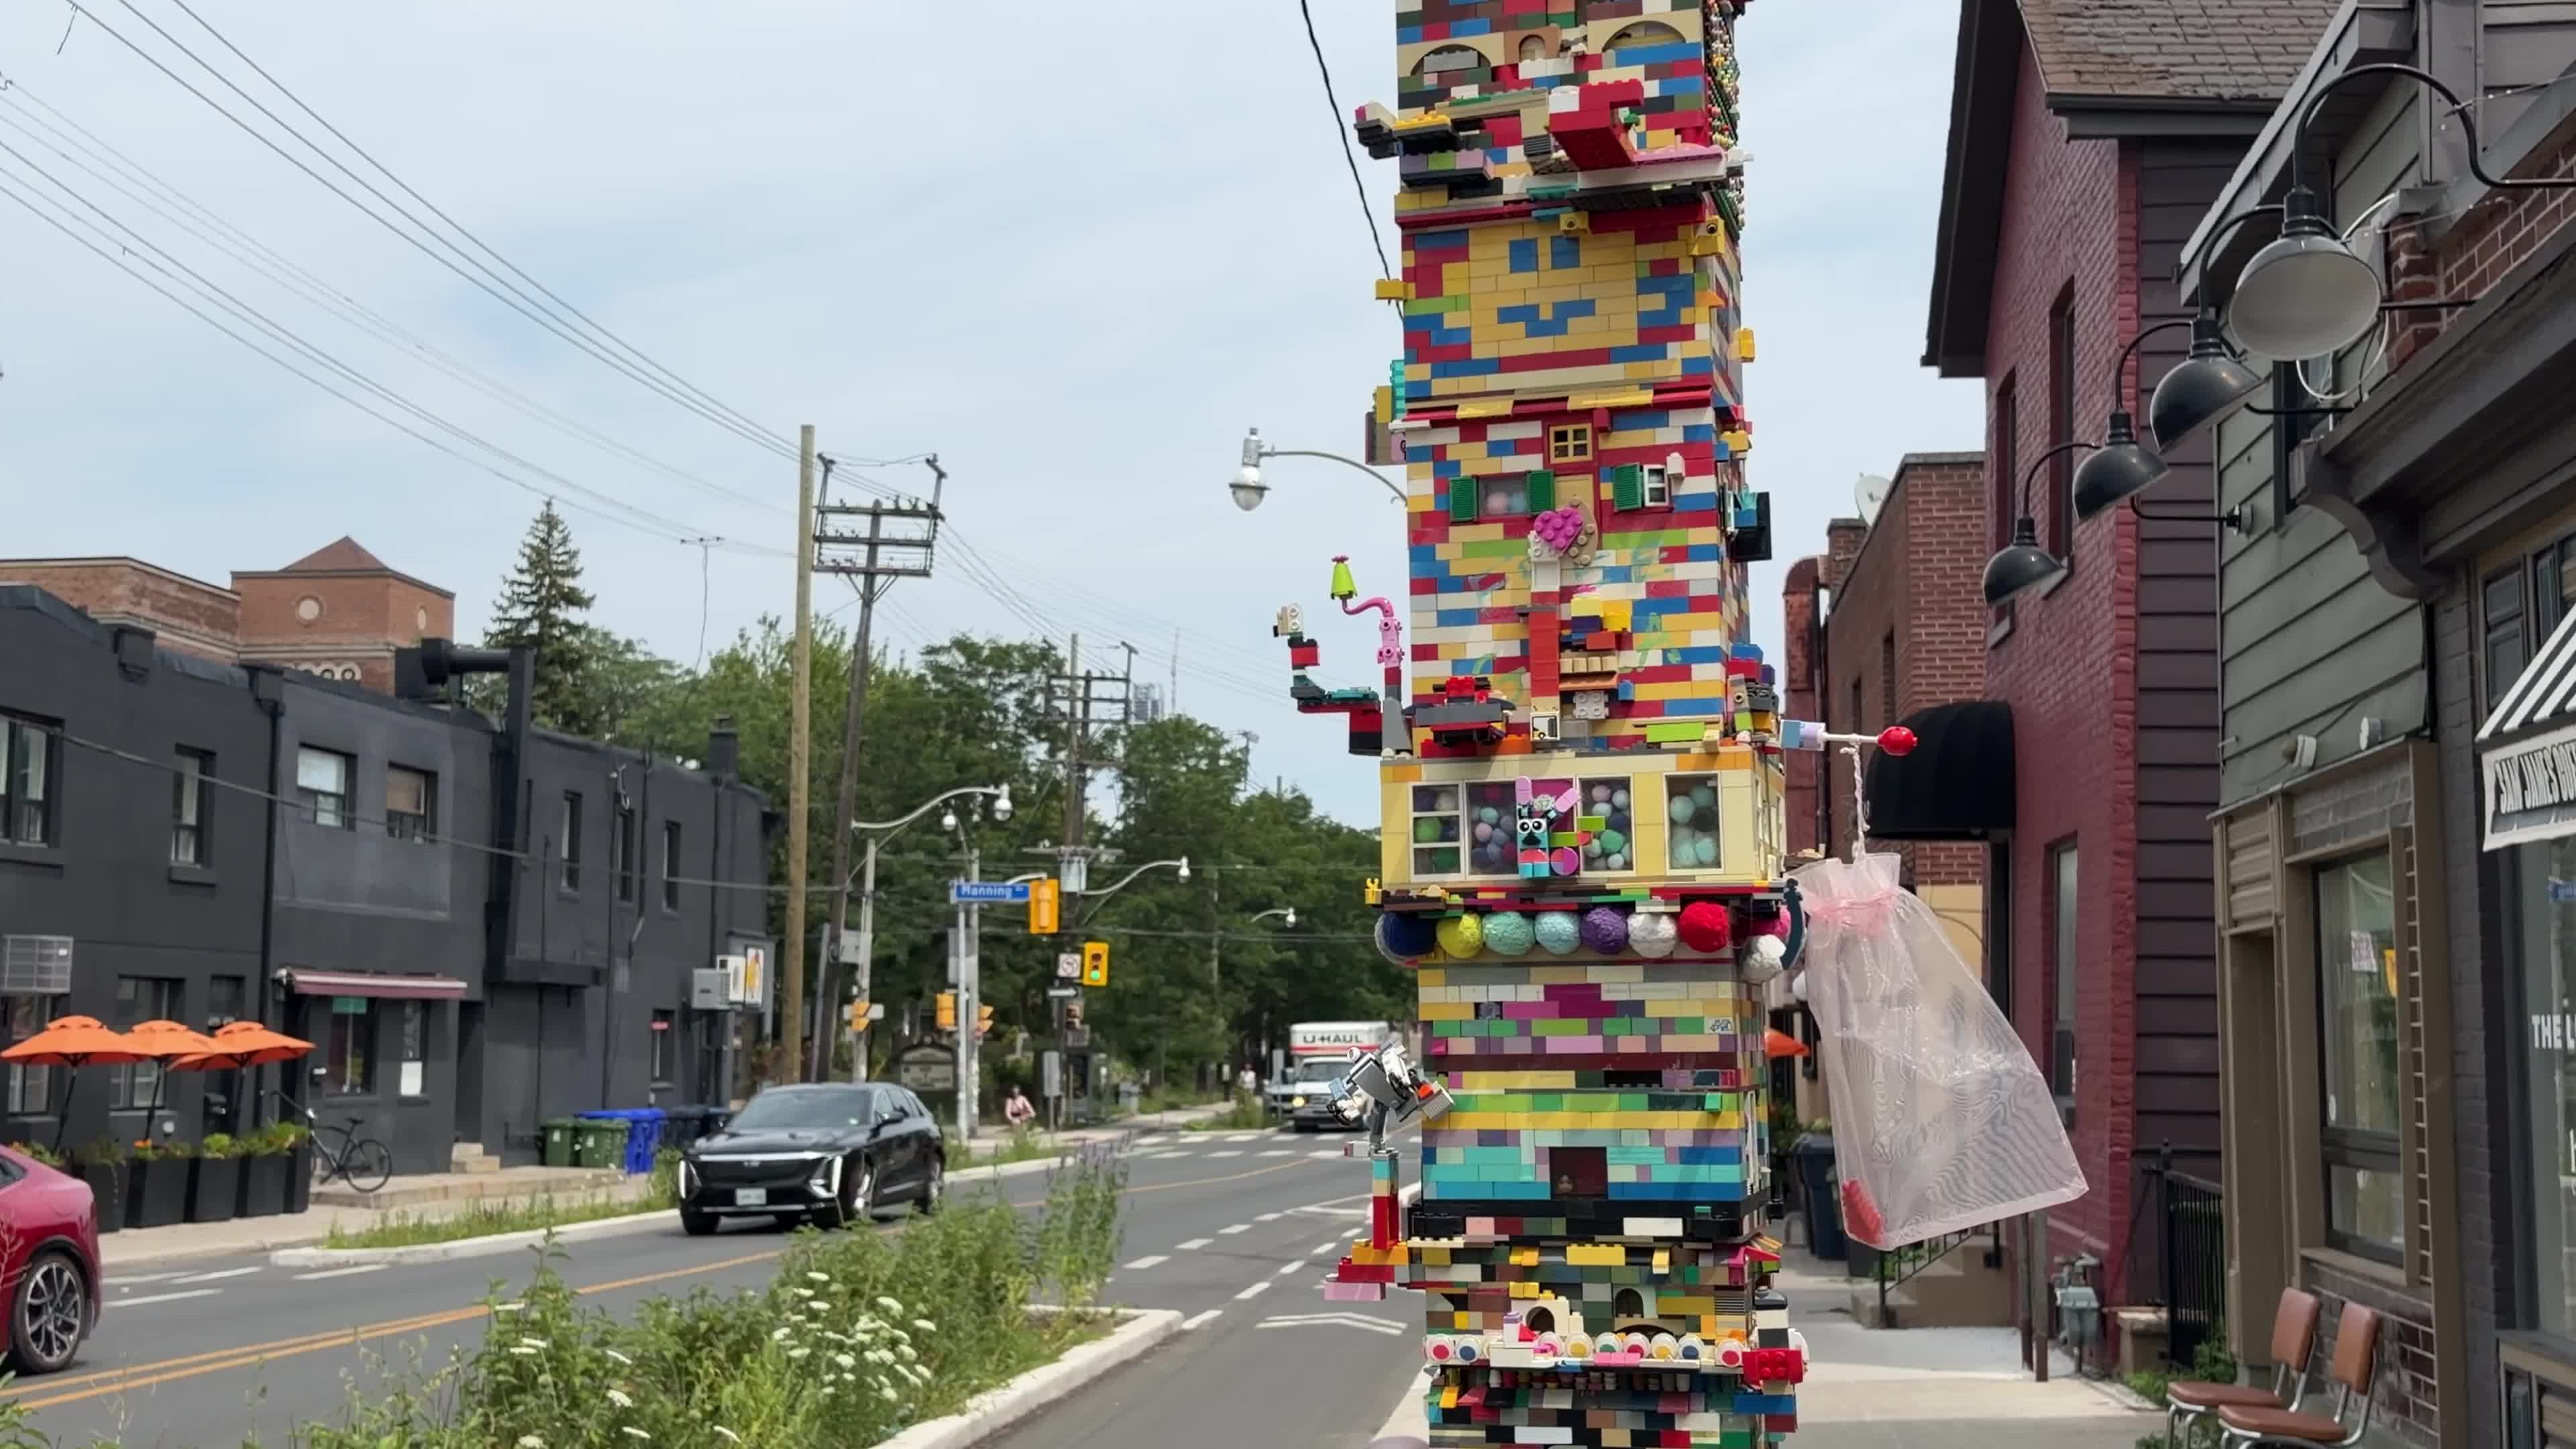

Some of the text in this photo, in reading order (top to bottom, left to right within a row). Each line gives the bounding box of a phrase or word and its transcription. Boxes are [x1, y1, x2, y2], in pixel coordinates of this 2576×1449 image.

[2495, 757, 2523, 814] SAM
[2518, 747, 2559, 809] JAMES
[961, 885, 1012, 900] Manning
[2531, 1014, 2562, 1049] THE
